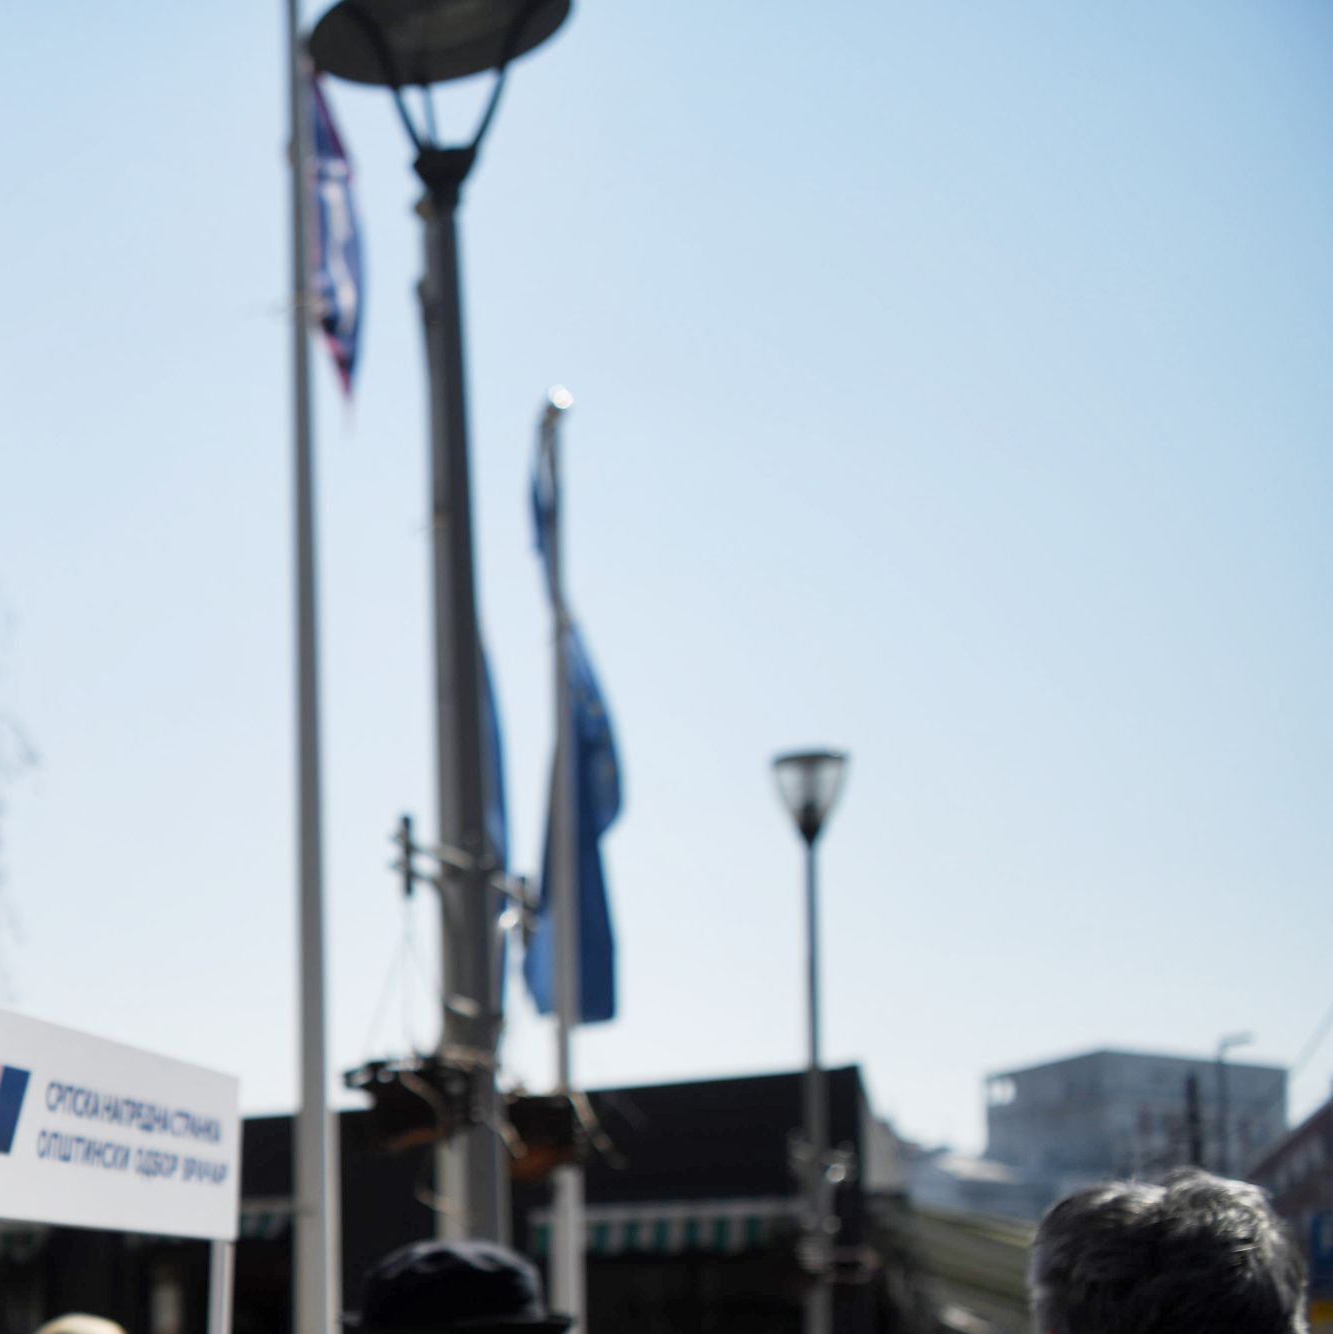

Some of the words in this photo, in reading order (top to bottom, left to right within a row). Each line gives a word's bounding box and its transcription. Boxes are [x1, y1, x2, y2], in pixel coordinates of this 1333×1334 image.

[45, 1080, 100, 1119] СРПСКА
[101, 1095, 170, 1133] НАПРЕДНА
[171, 1109, 222, 1145] СТРАНКА
[36, 1129, 131, 1170] ОПШТИНСКИ
[135, 1147, 179, 1179] ОДБОР
